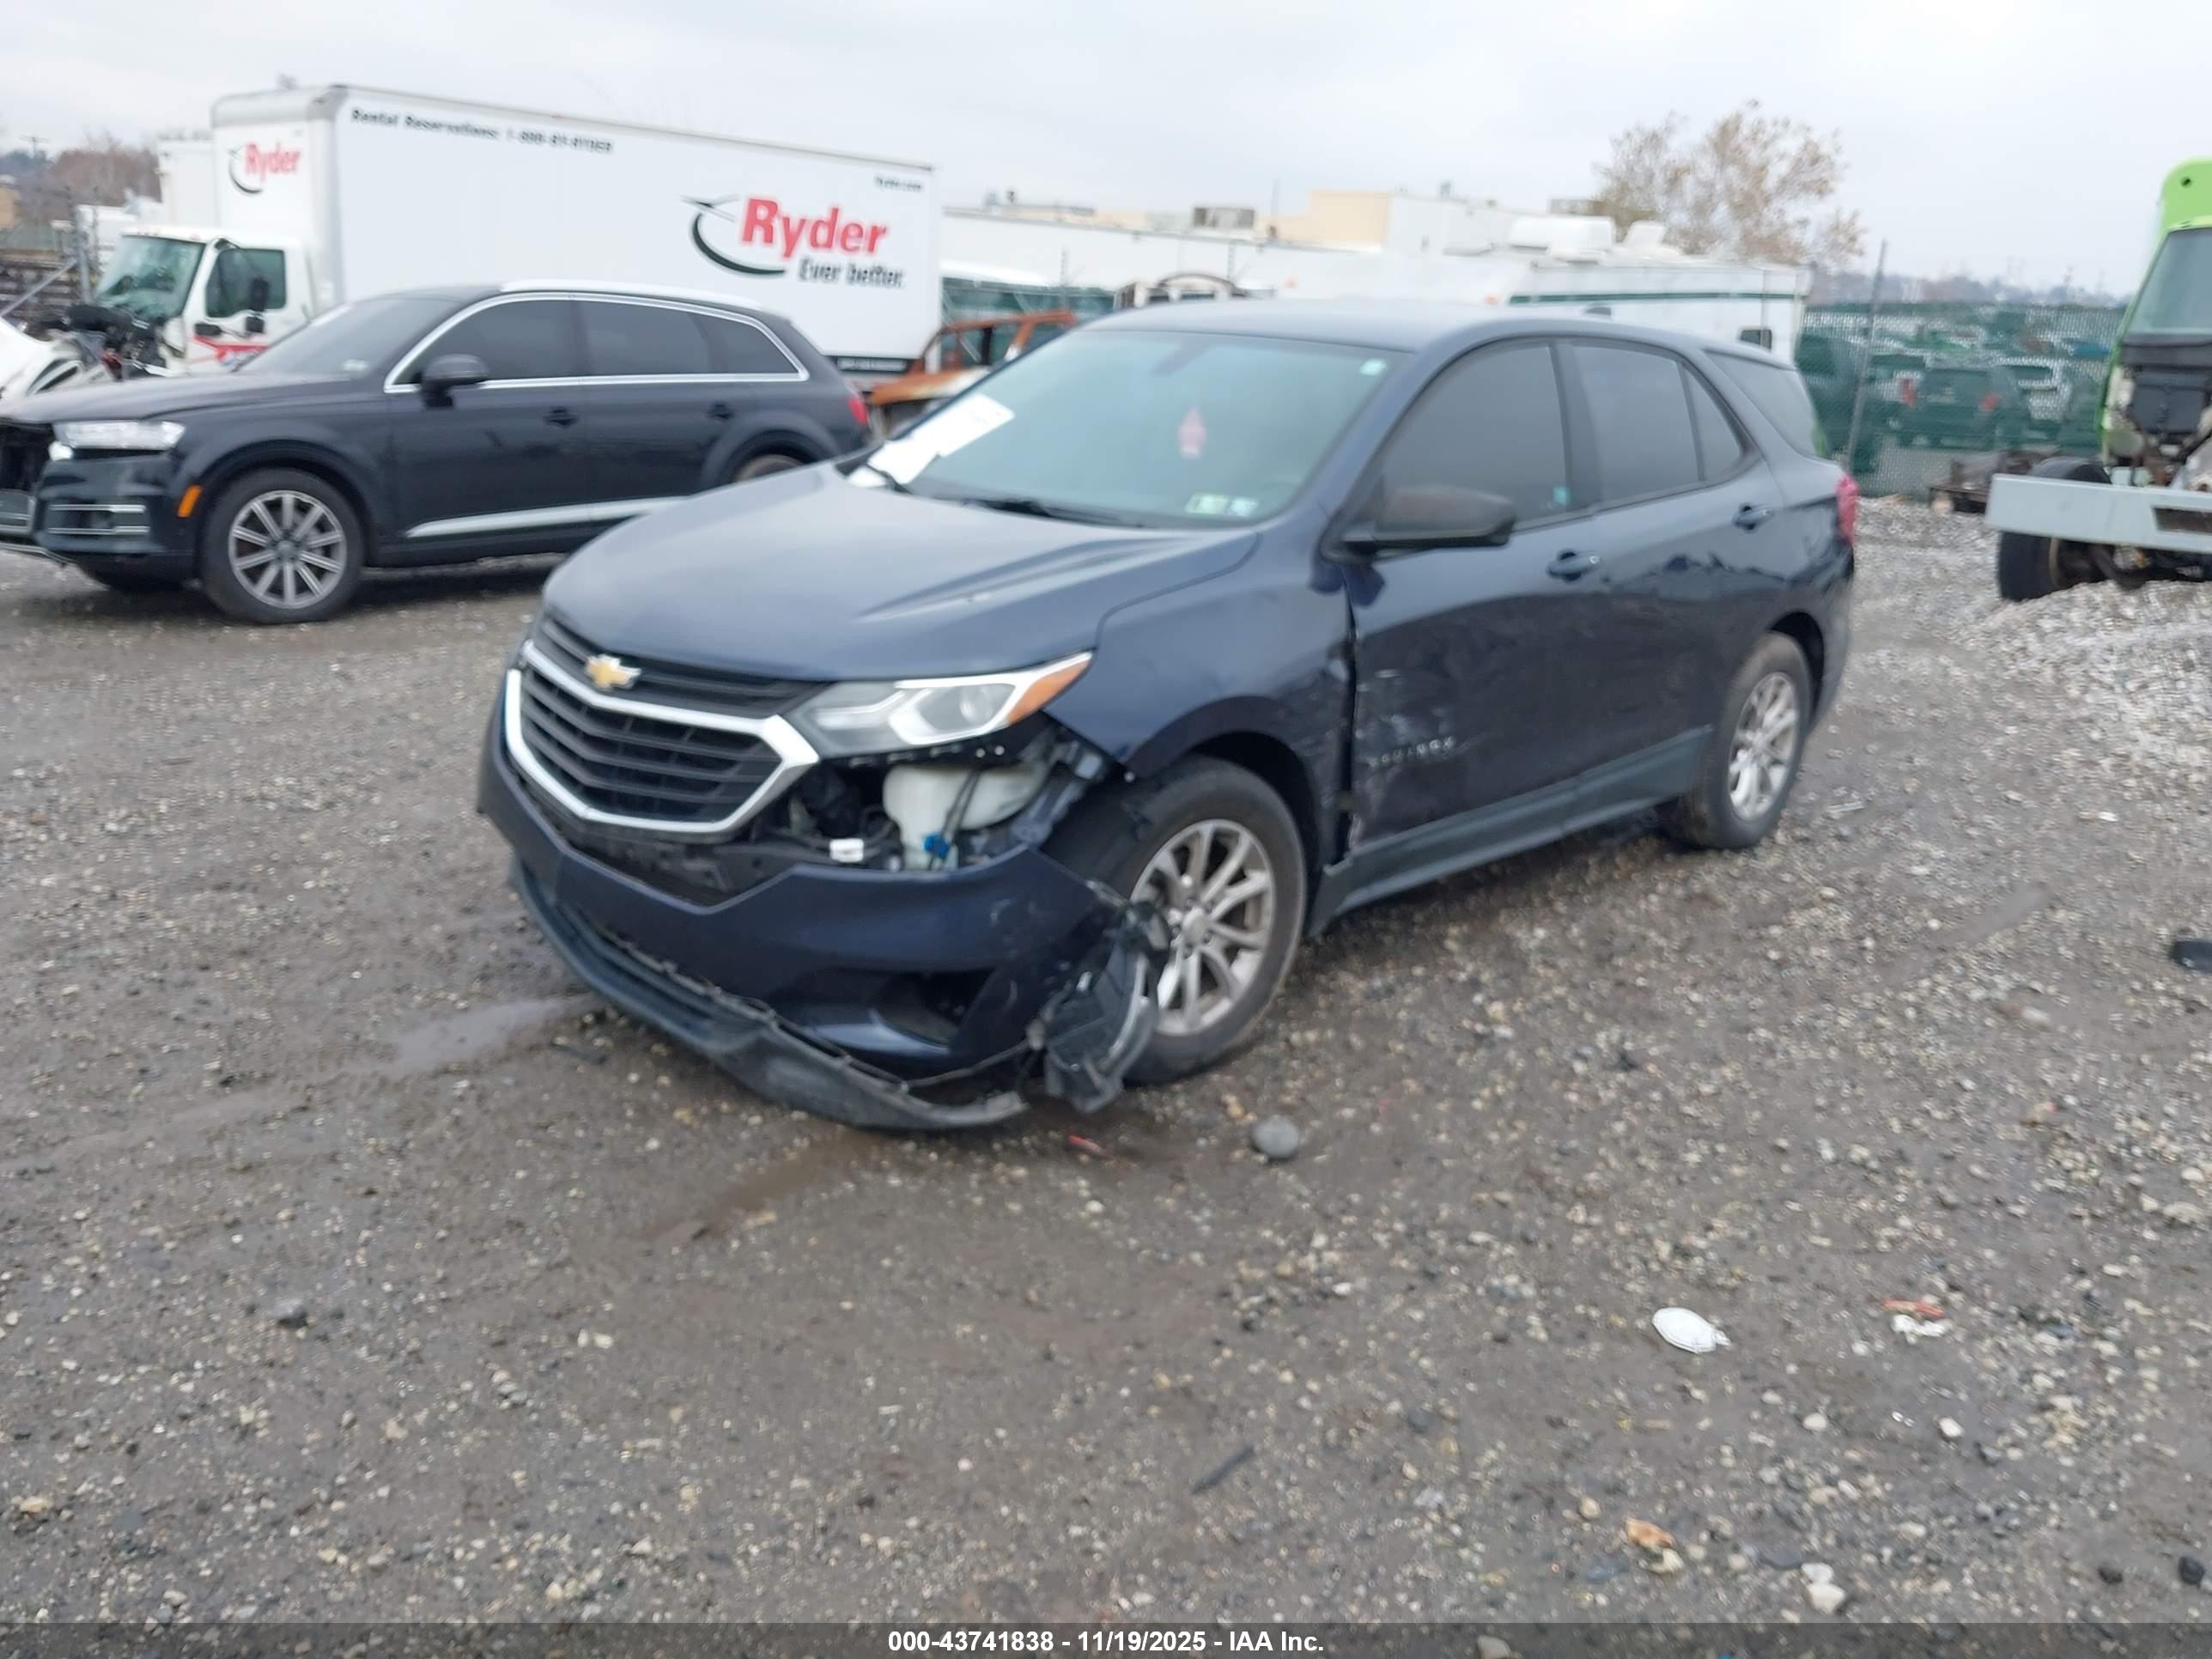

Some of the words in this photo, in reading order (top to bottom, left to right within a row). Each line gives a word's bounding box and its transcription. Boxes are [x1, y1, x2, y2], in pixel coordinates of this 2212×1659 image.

[244, 142, 301, 180] Ryder
[739, 198, 889, 259] Ryder
[798, 257, 843, 282] Ever
